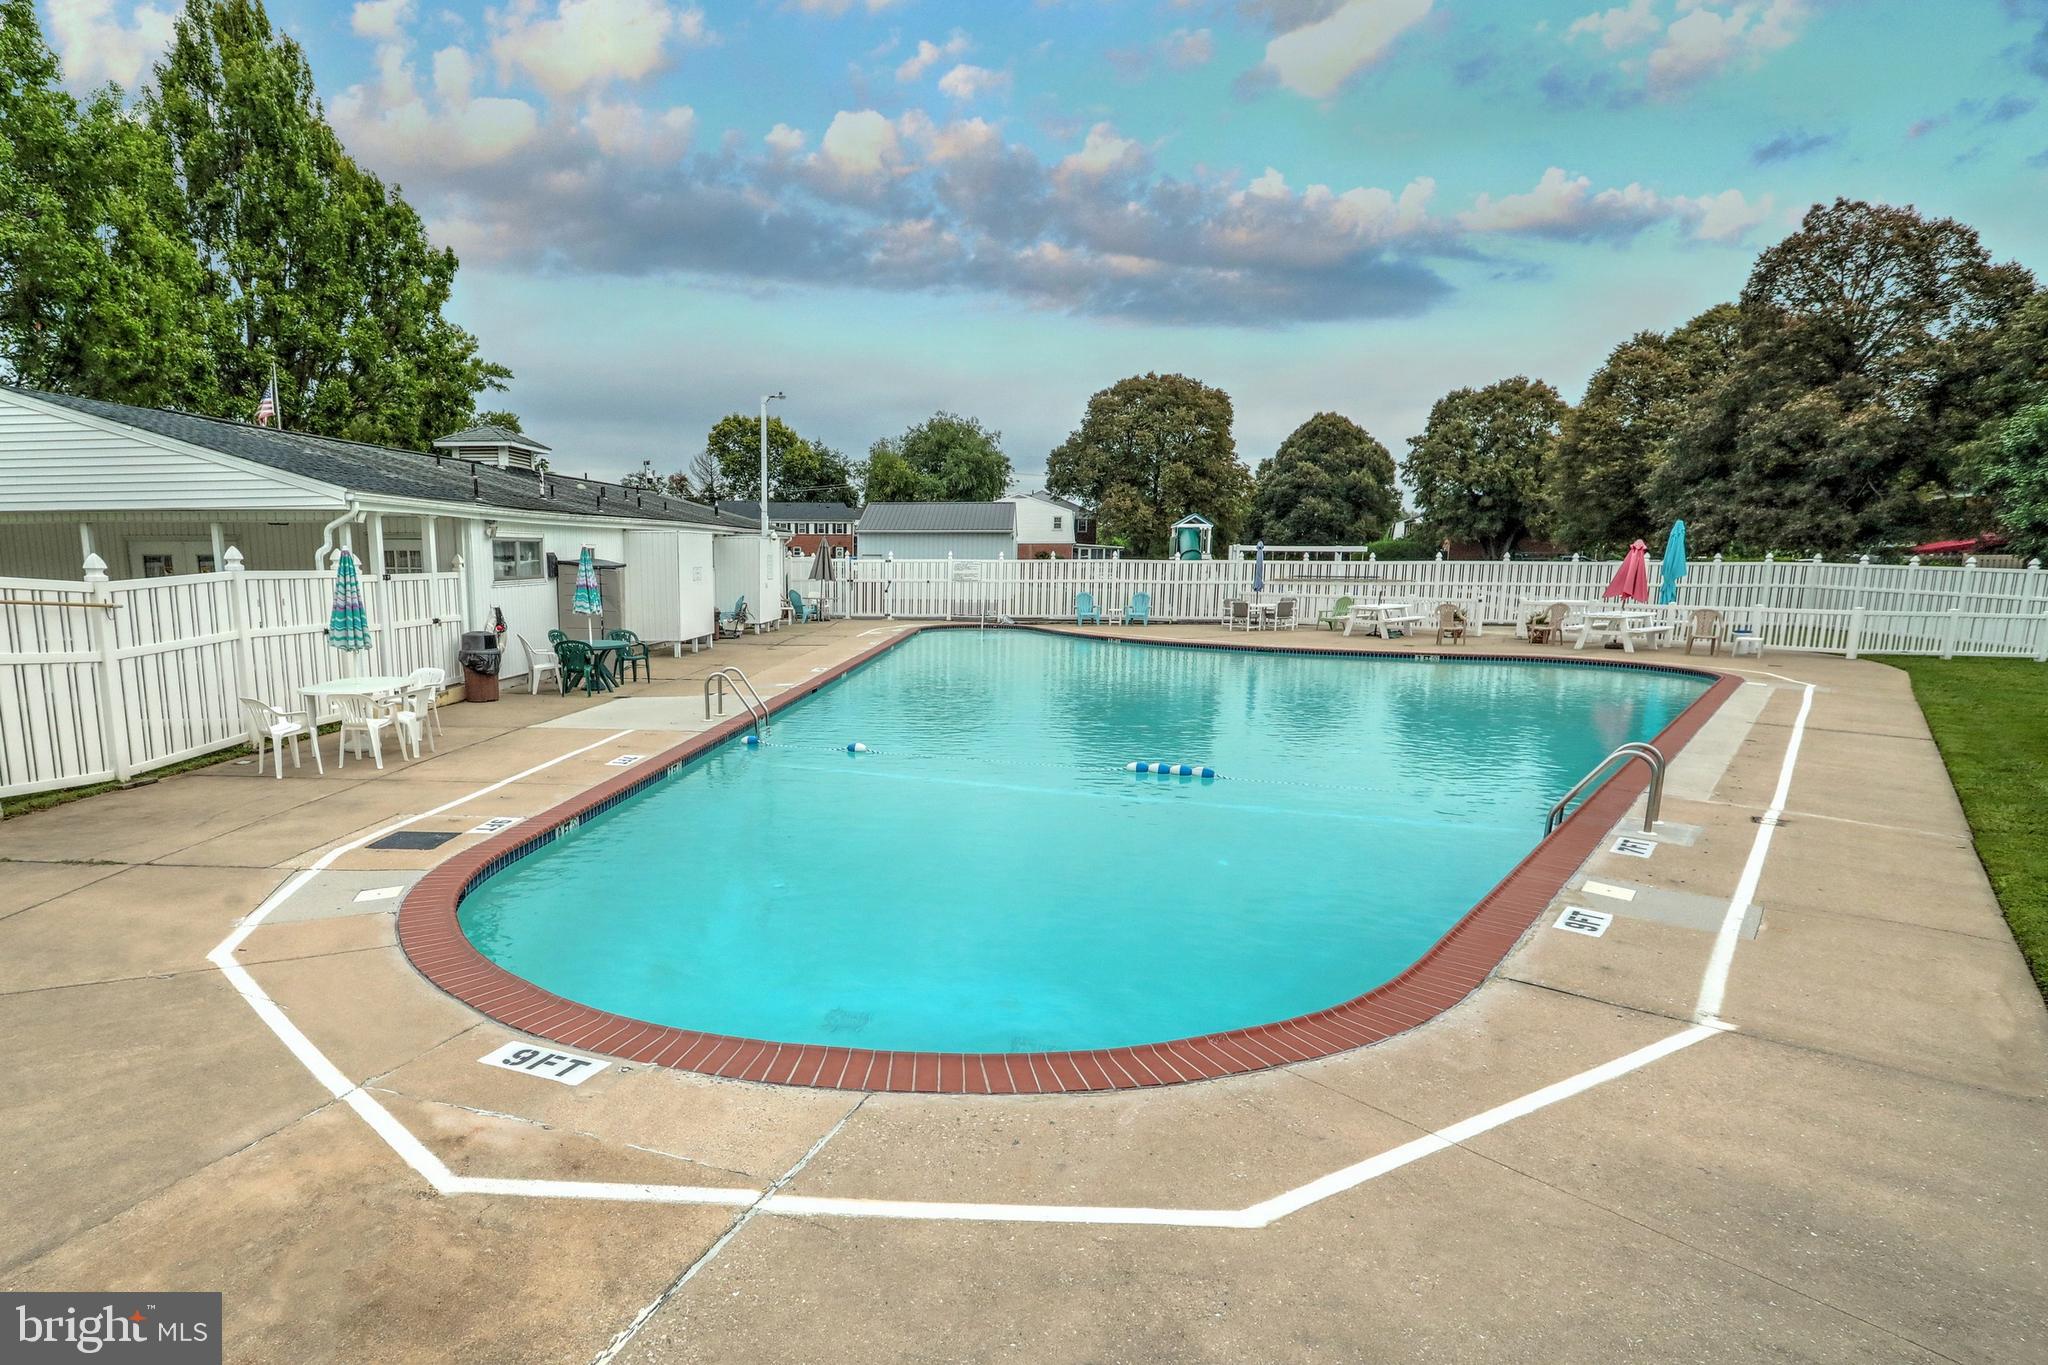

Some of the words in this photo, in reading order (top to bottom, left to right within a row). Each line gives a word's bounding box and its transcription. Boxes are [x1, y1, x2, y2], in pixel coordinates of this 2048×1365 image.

[475, 819, 513, 832] 9FT
[1617, 839, 1650, 855] 7FT
[1564, 910, 1605, 932] 9FT
[502, 1049, 592, 1077] 9FT
